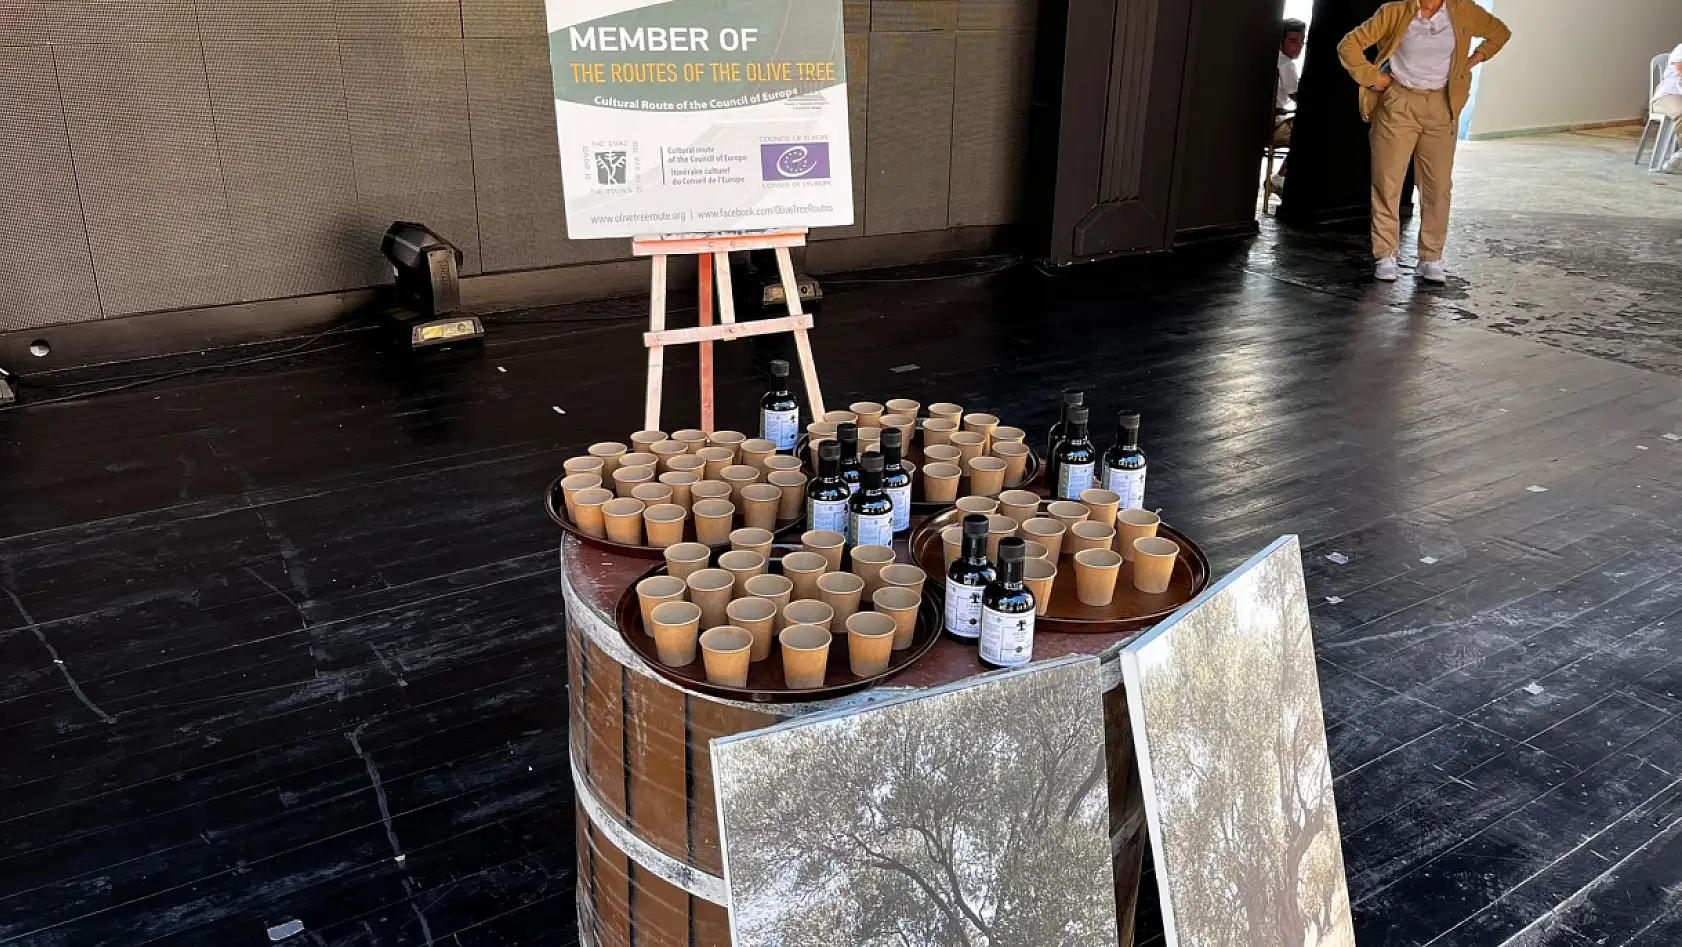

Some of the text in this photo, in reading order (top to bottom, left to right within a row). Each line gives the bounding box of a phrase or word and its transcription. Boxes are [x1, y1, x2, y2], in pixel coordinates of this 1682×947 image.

[569, 26, 758, 52] MEMBER OF
[570, 62, 836, 84] THE ROUTES OF THE OLIVE TREE
[593, 96, 639, 109] Cultural
[641, 100, 675, 110] Route
[676, 100, 688, 110] of
[689, 100, 708, 110] the
[709, 95, 748, 109] Council
[749, 93, 761, 104] of
[667, 146, 695, 154] Cultural
[668, 154, 747, 163] of the Council of Europe
[672, 177, 682, 185] du
[683, 176, 706, 185] Conseil
[708, 176, 716, 184] de
